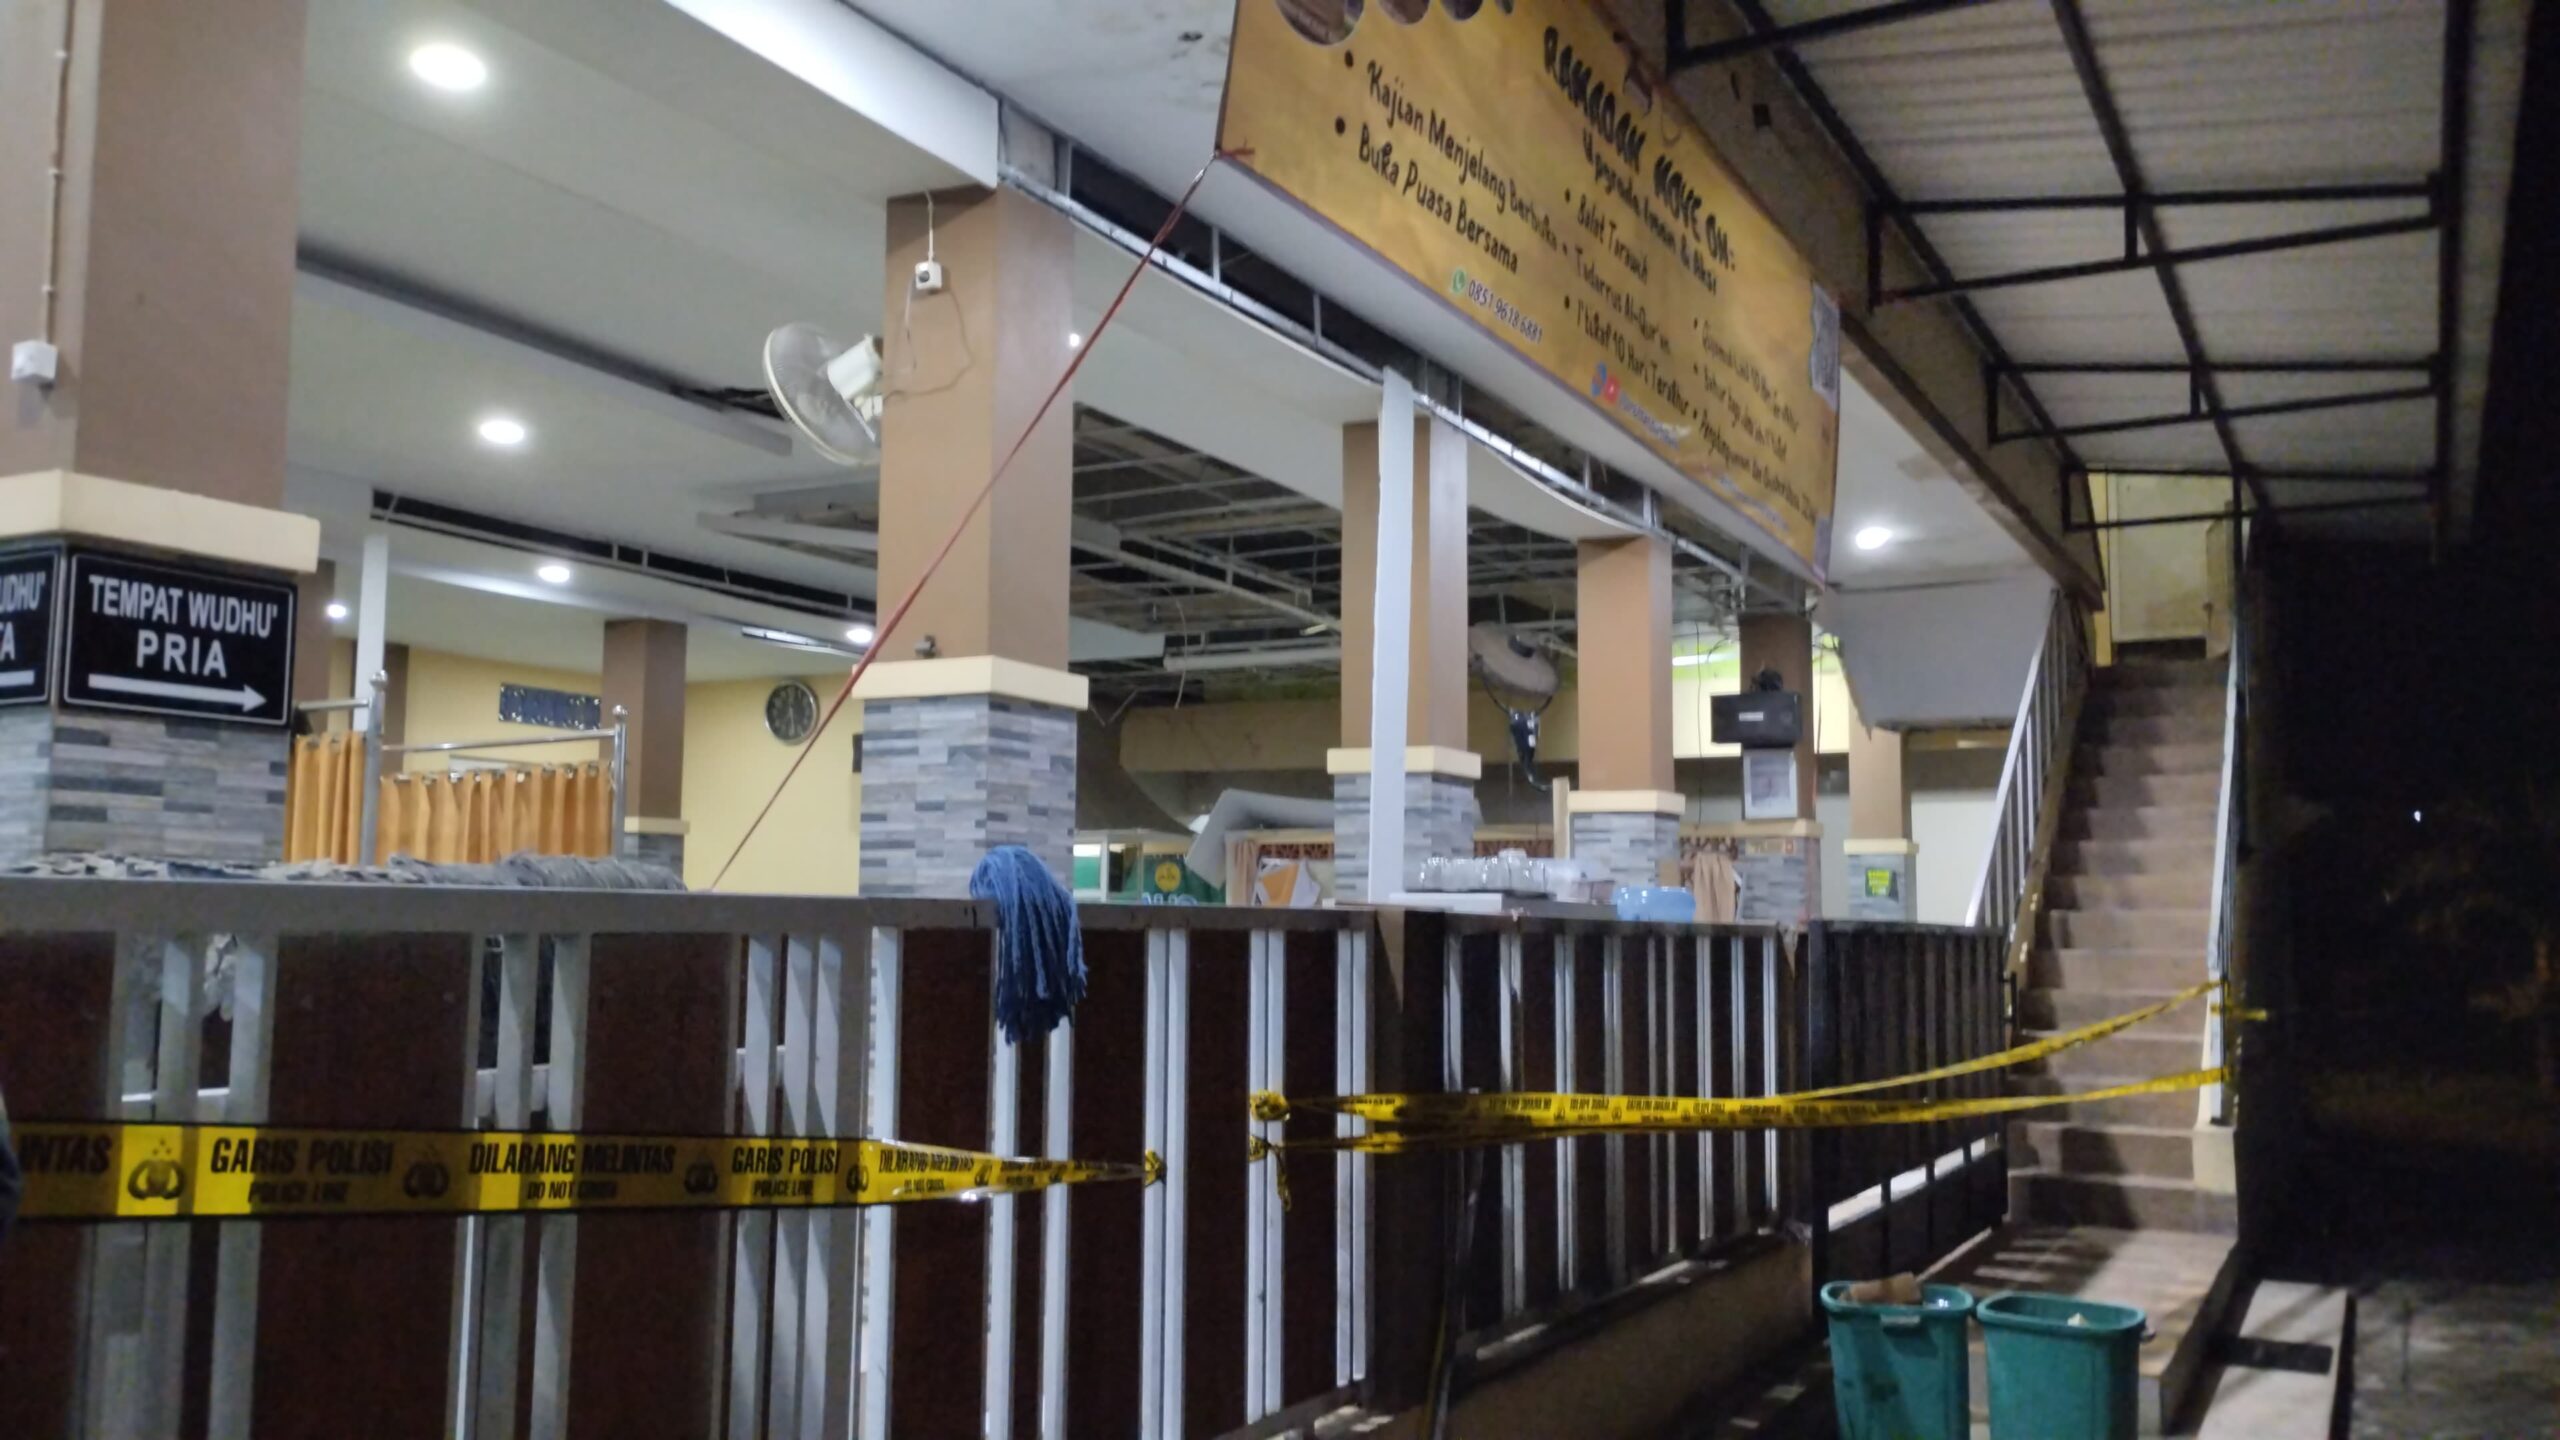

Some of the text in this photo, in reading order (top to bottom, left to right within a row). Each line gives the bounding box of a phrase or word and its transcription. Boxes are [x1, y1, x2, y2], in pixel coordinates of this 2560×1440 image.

[1367, 60, 1558, 252] Kajian Menjelang Berbuka
[1358, 121, 1518, 275] Buka Puasa Bersama
[1653, 154, 1702, 243] MOVE
[1468, 279, 1494, 309] 0851
[1495, 298, 1520, 329] 9618
[0, 571, 46, 613] DHU'
[89, 574, 278, 638] TEMPAT WUDHU'
[136, 629, 227, 679] PRIA
[210, 1137, 395, 1175] GARIS POLISI
[468, 1142, 676, 1174] DILARANG MELINTAS
[732, 1146, 841, 1175] GARIS POLISI
[527, 1181, 546, 1200] DO
[548, 1181, 576, 1199] NOT
[753, 1180, 814, 1198] POLICE LINE
